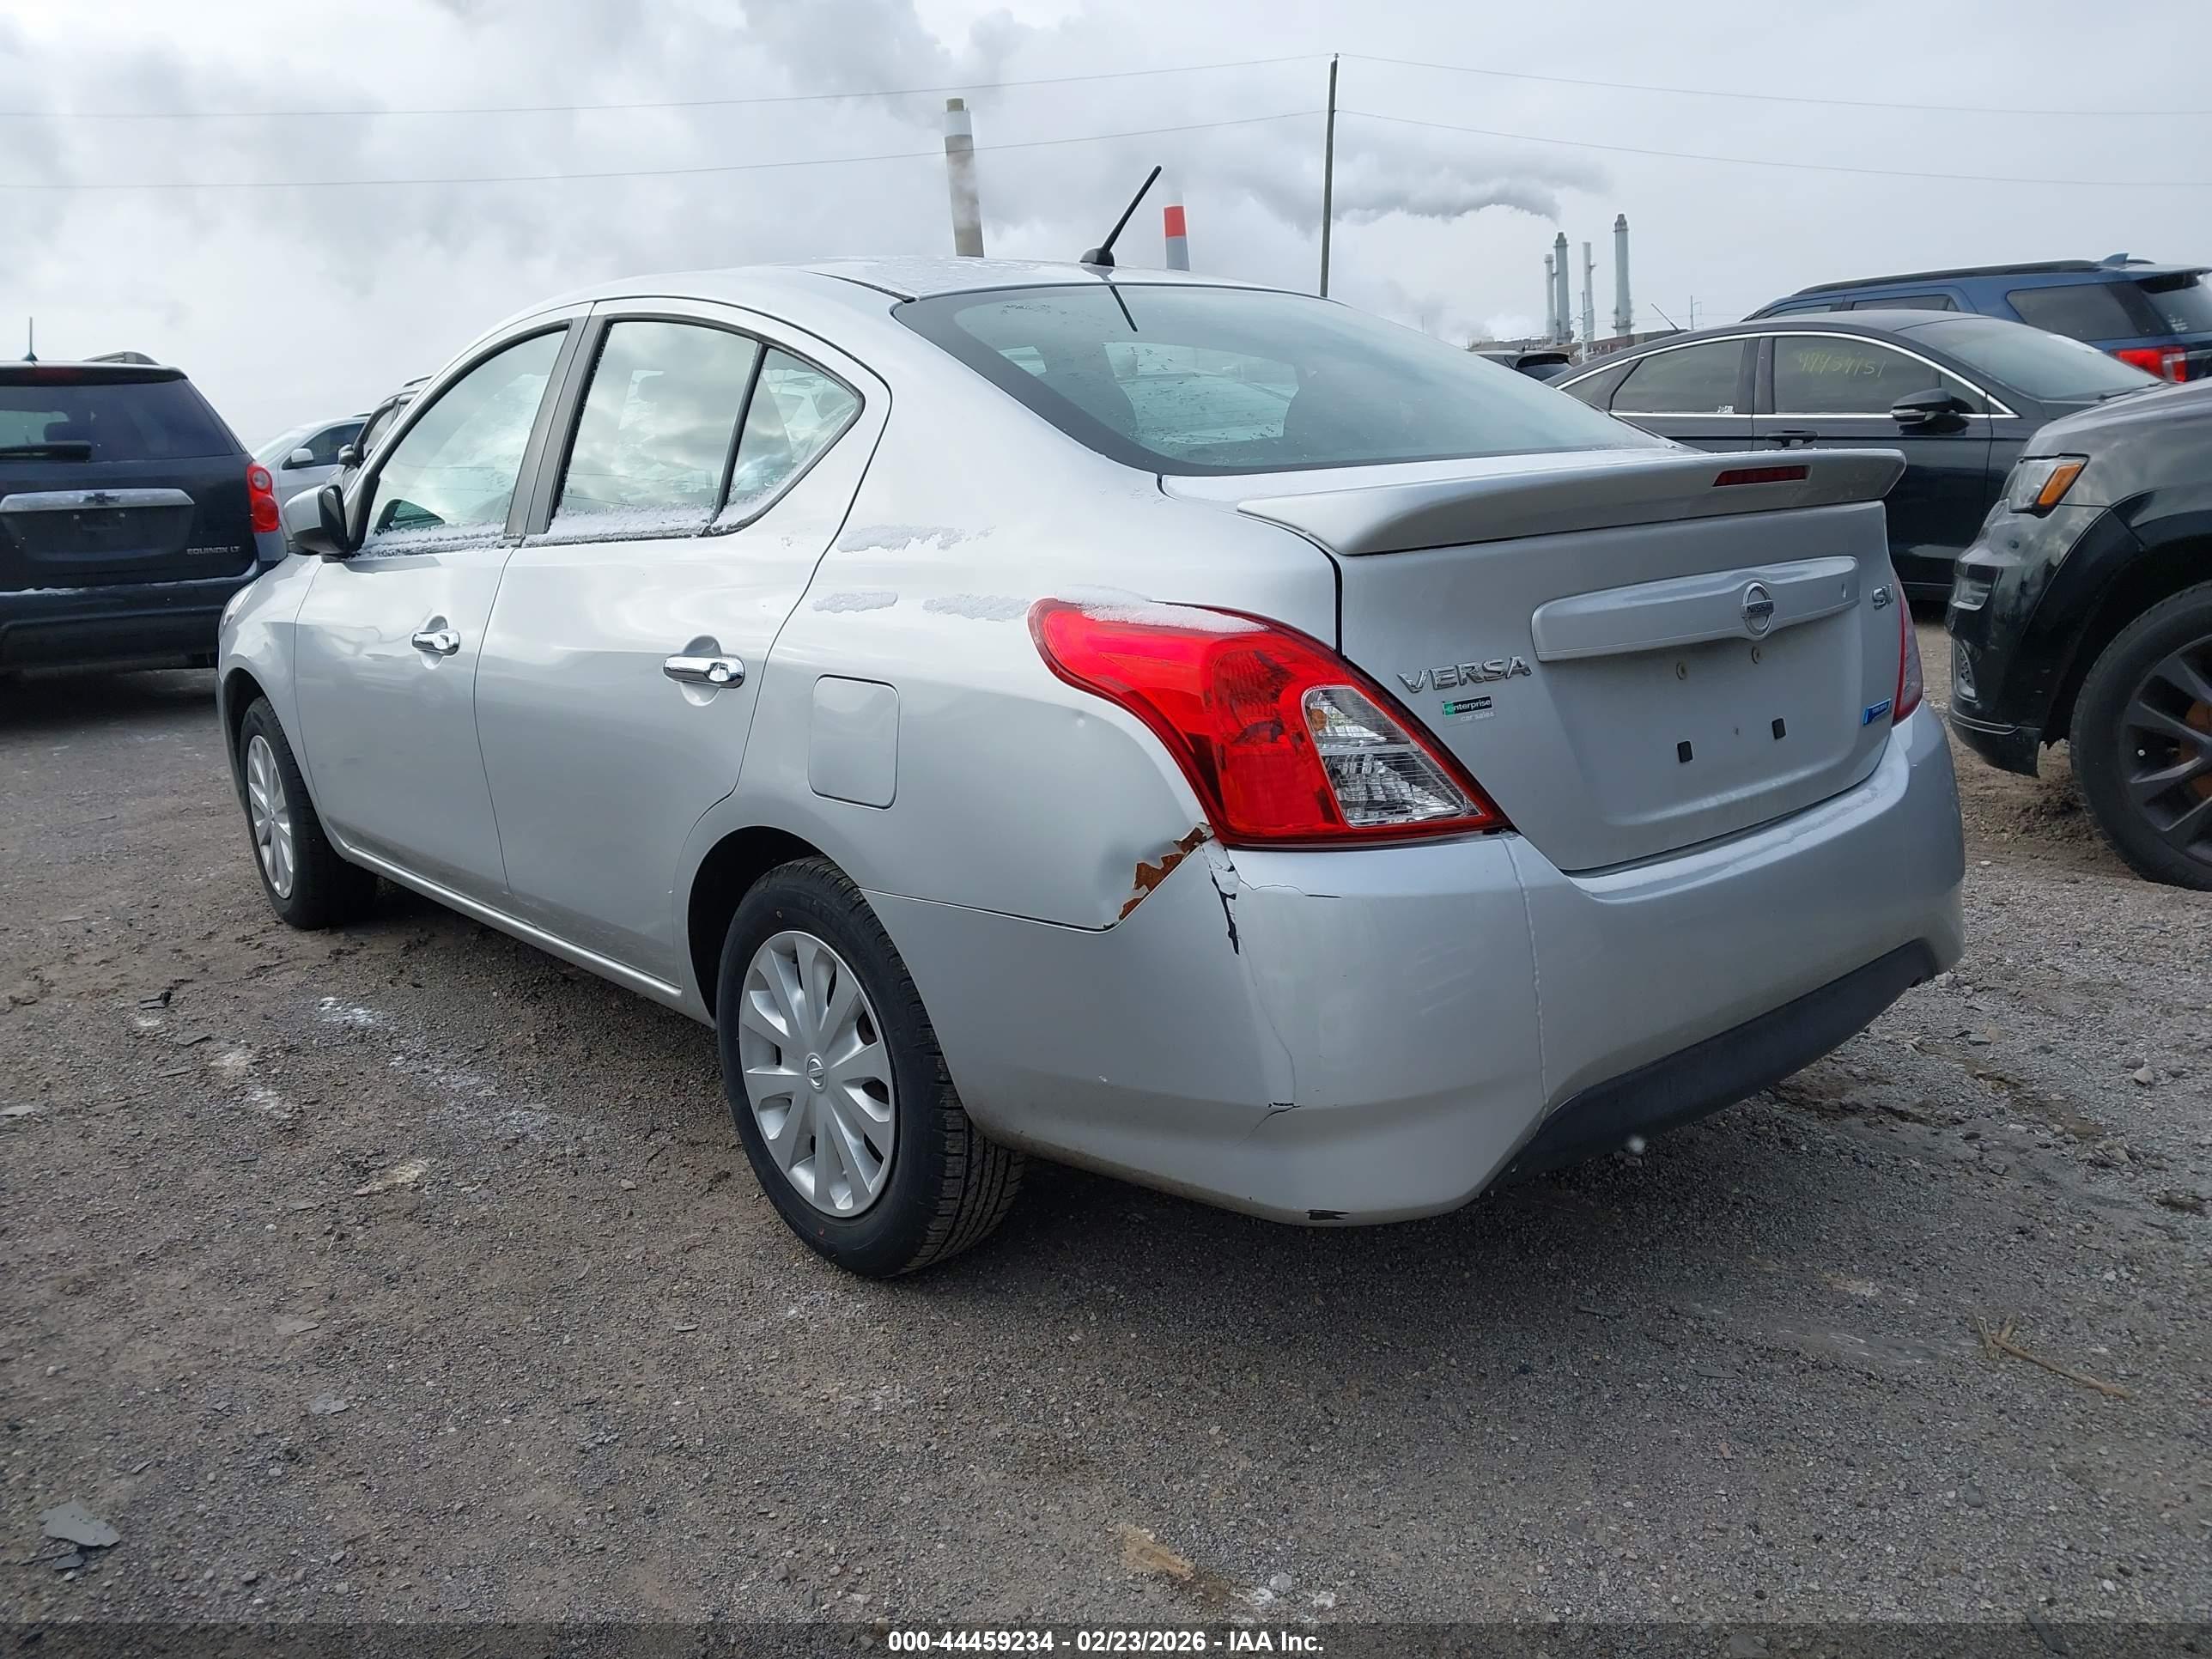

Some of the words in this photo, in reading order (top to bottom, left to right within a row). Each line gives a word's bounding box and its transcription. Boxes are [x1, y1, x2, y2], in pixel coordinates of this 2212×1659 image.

[186, 546, 228, 556] EQUINOX
[1745, 602, 1774, 613] NISSAN
[1397, 655, 1532, 694] VERSA
[1444, 698, 1492, 712] enterprise
[1475, 711, 1495, 720] sales
